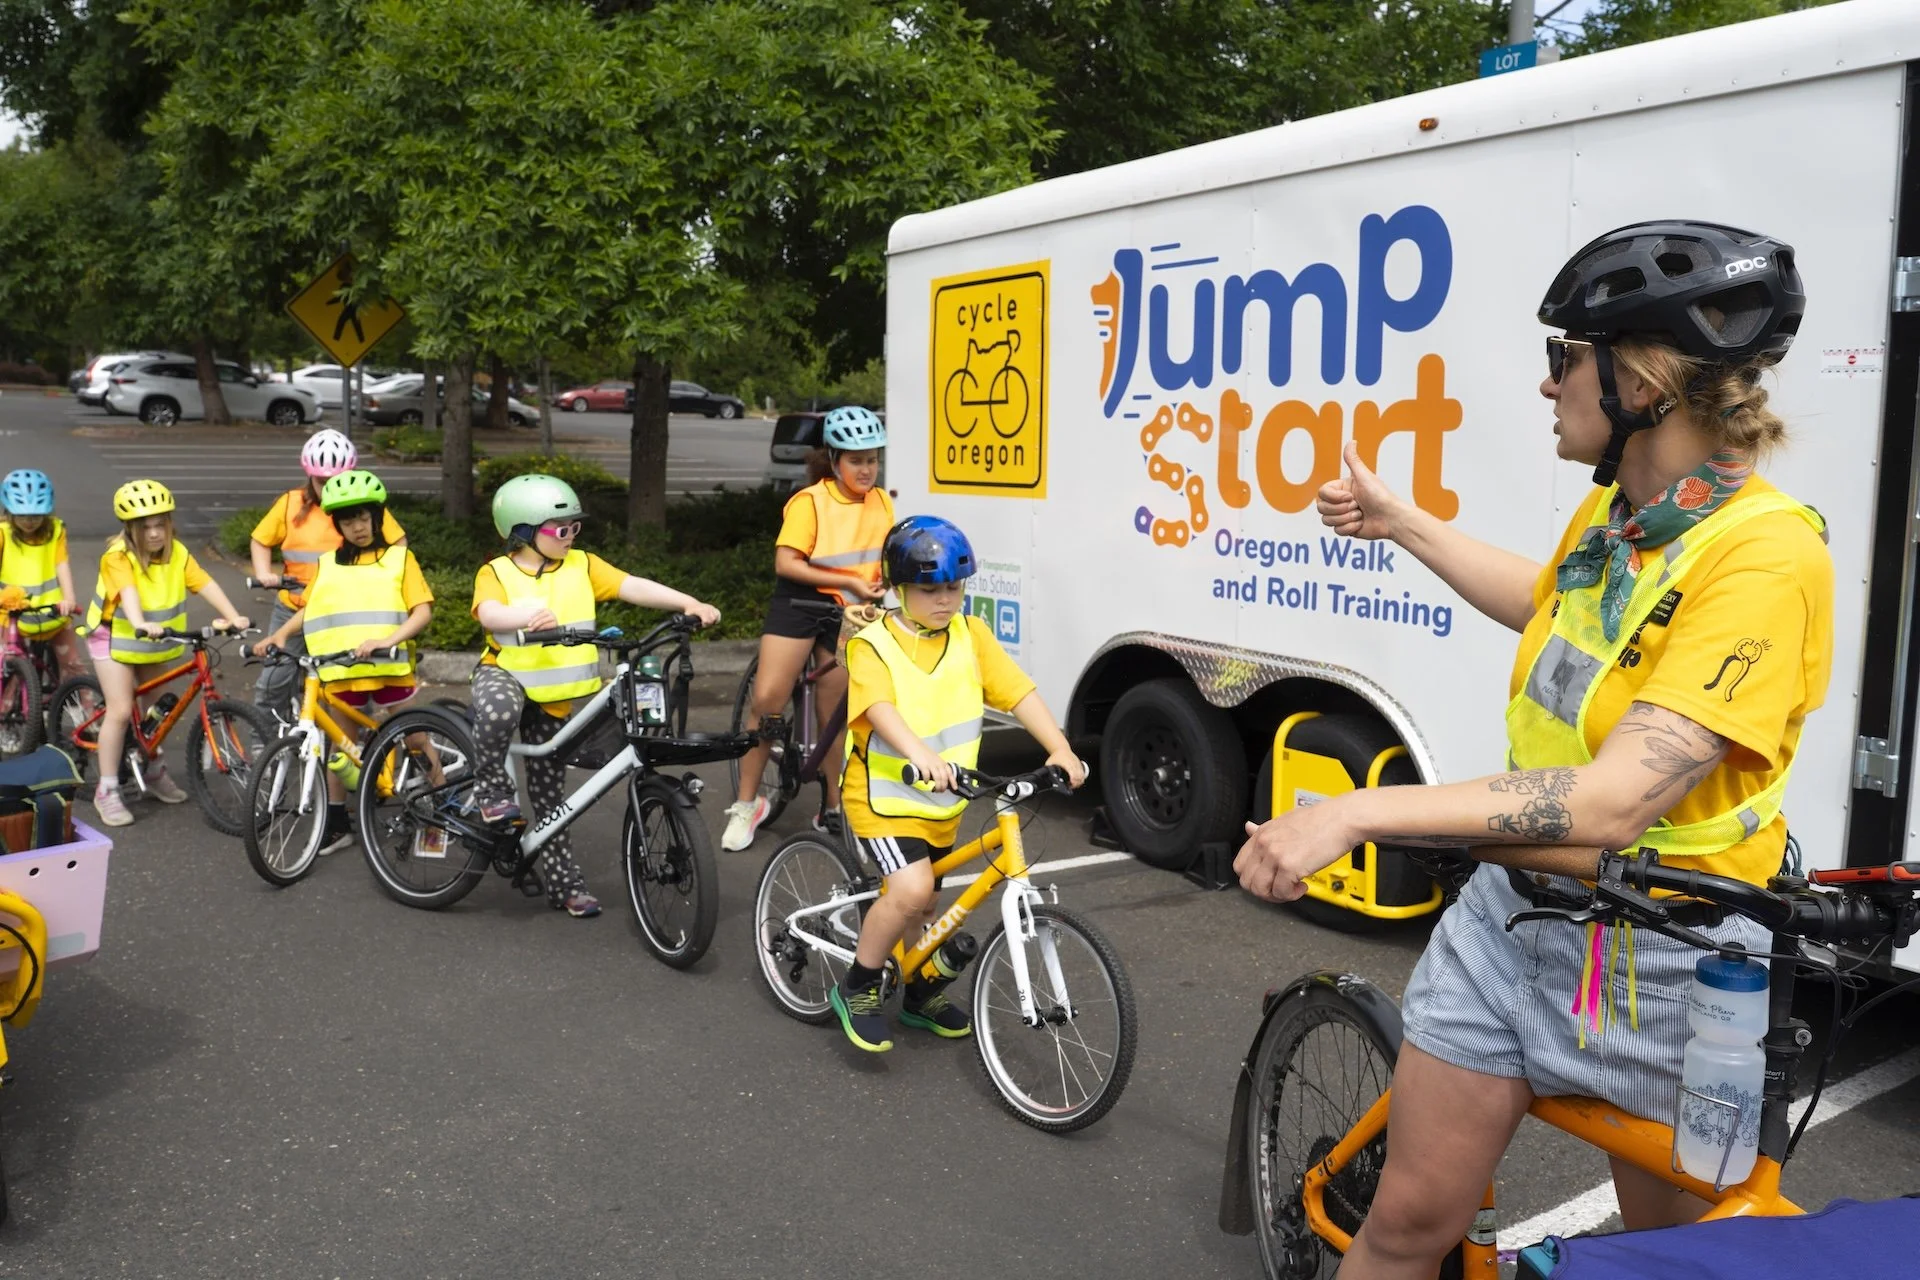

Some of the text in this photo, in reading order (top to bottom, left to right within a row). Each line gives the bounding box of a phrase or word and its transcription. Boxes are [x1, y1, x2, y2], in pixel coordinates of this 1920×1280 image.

[1495, 52, 1522, 72] LOT
[957, 292, 1018, 333] cycle
[1091, 204, 1453, 419] Jump
[947, 443, 1025, 473] oregon
[1214, 528, 1395, 574] Oregon Walk
[979, 575, 988, 592] to
[990, 574, 1021, 597] School
[1212, 575, 1453, 638] and Roll Training
[534, 801, 573, 833] woom
